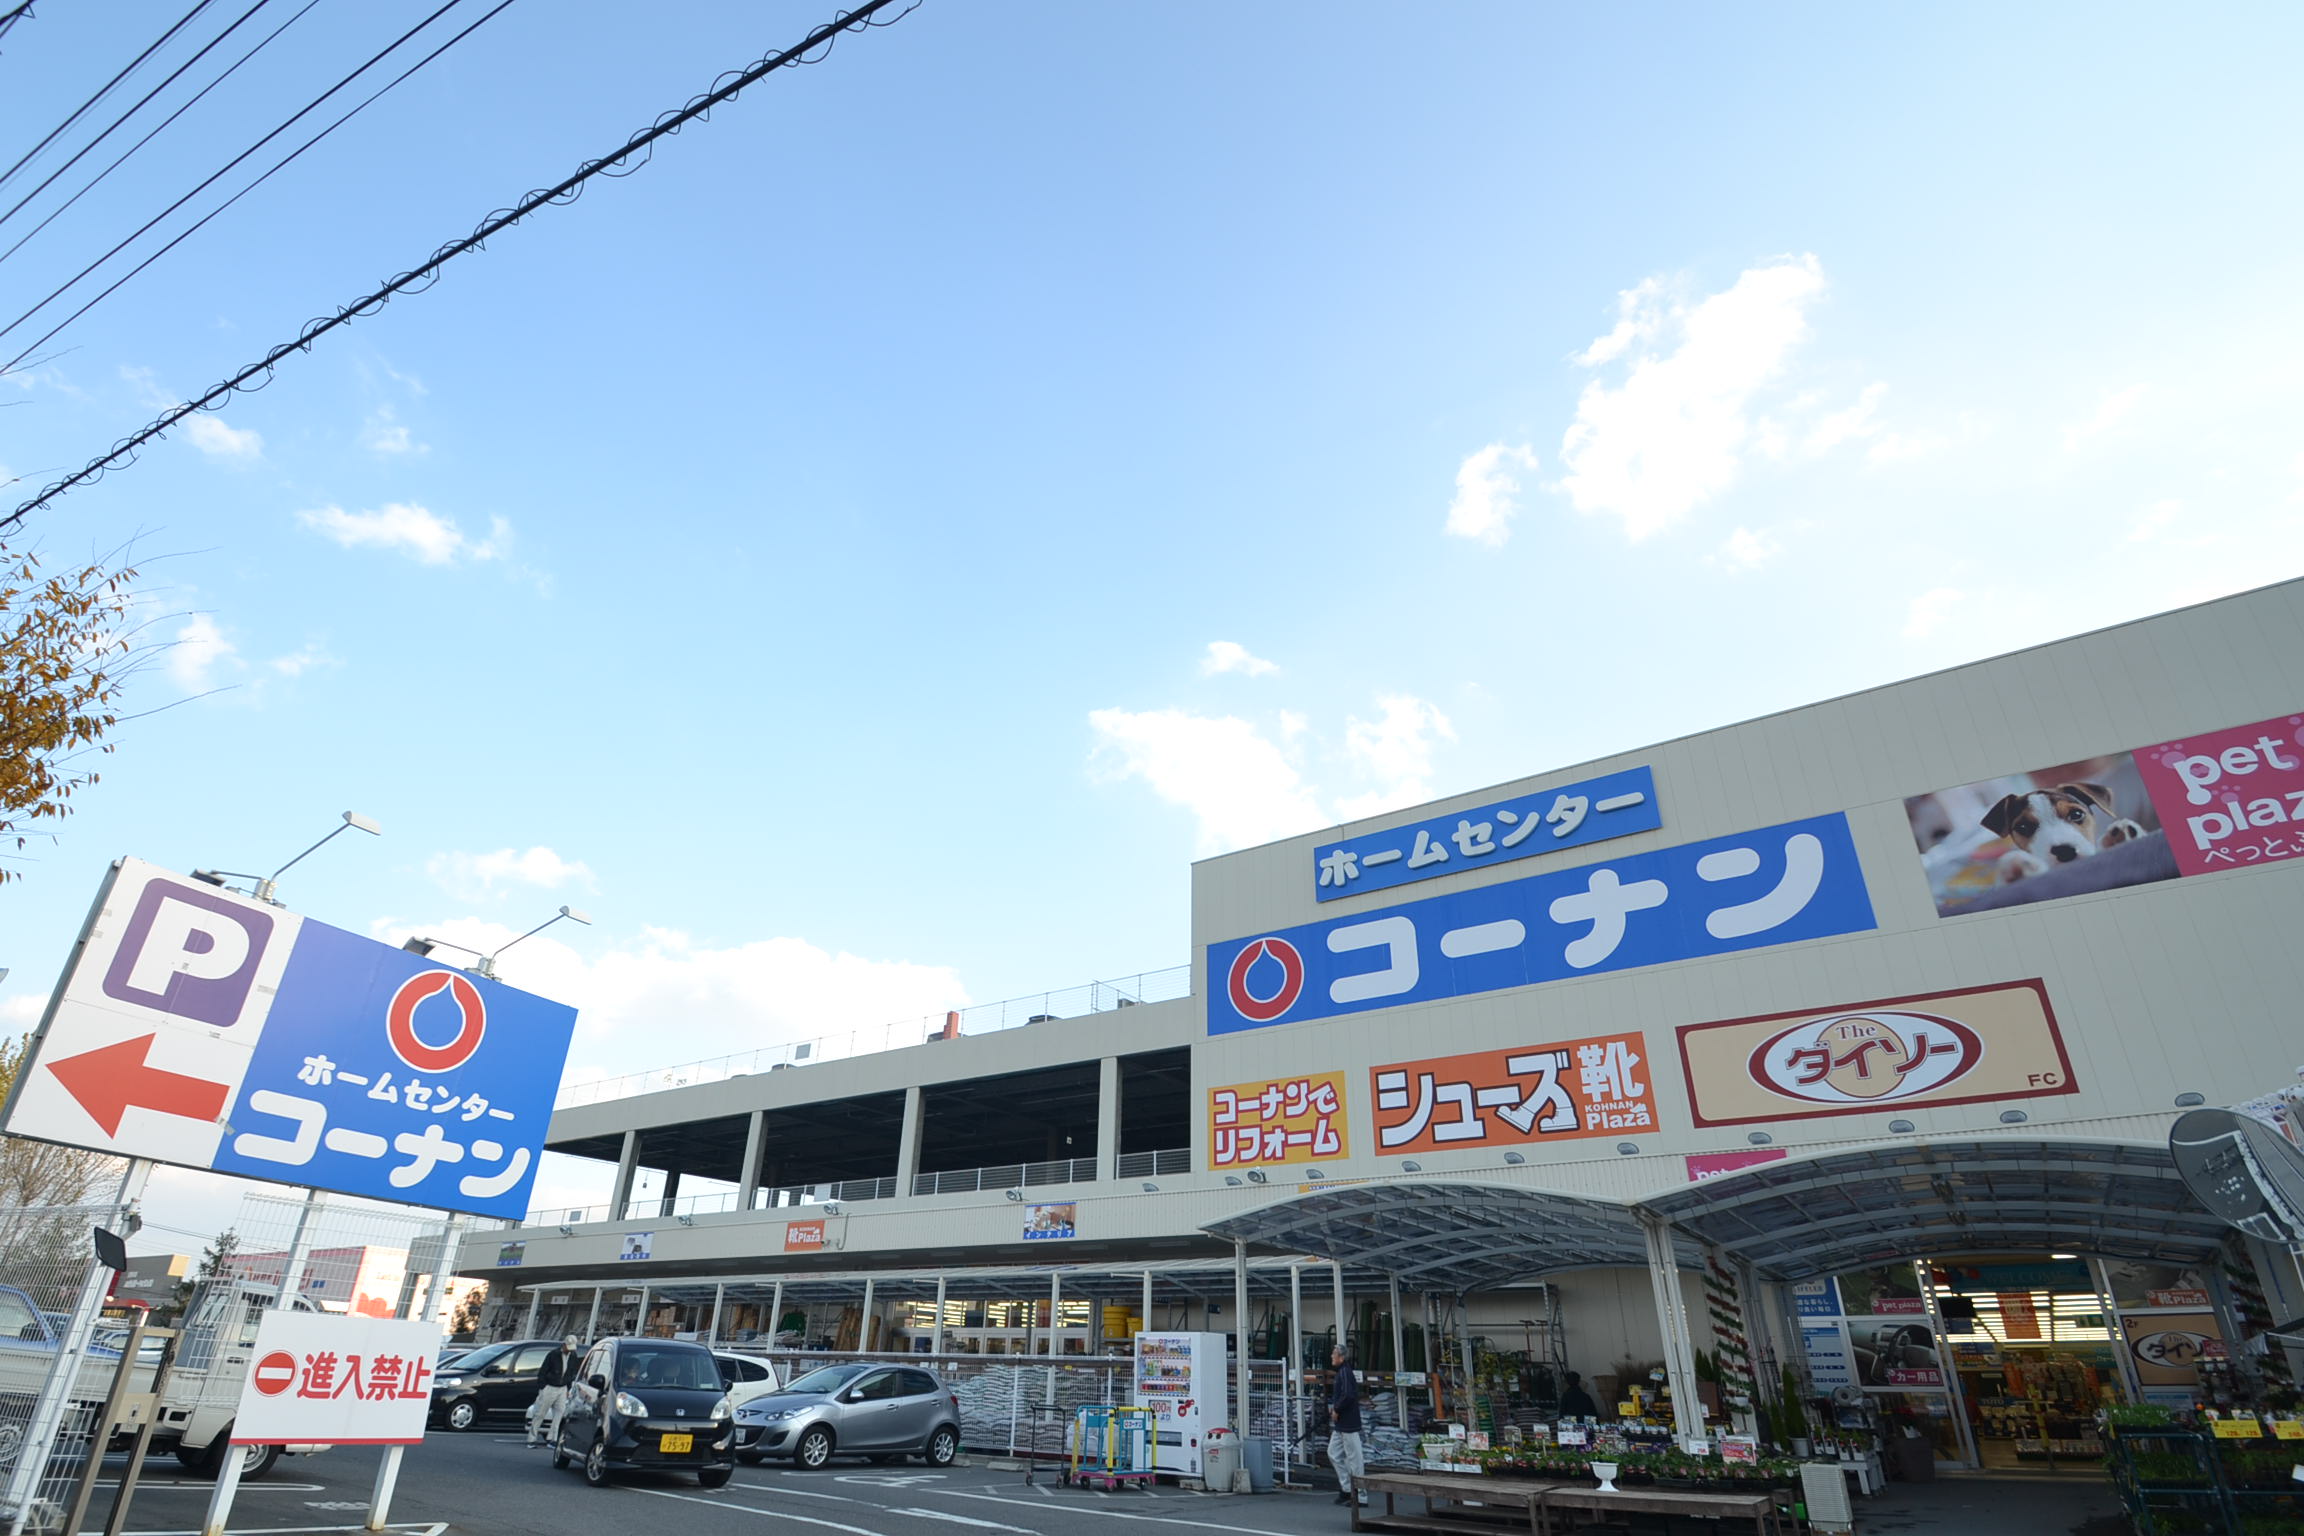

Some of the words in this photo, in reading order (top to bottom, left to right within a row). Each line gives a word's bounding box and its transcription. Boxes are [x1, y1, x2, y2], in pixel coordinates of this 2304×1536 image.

[2173, 736, 2295, 806] pet
[1318, 791, 1646, 888] ホームセンター
[1326, 833, 1824, 1004] コーナン
[126, 896, 250, 996] P
[1835, 1024, 1876, 1041] The
[1577, 1041, 1645, 1103] 靴
[1785, 1032, 1959, 1087] ダイソー
[2027, 1072, 2058, 1088] FC
[297, 1054, 515, 1122] ホームセンター
[1213, 1079, 1340, 1127] コーナンで
[1376, 1048, 1580, 1148] シューズ
[1585, 1101, 1634, 1113] KOHNAN
[233, 1090, 531, 1198] コーナン
[1214, 1117, 1342, 1167] リフォーム
[1586, 1111, 1651, 1130] Plaza
[799, 1232, 820, 1243] Plaza
[1882, 1302, 1897, 1311] pet
[1898, 1302, 1921, 1310] plaza
[2173, 1294, 2207, 1304] Plaza
[296, 1351, 431, 1401] 進入禁止
[1896, 1370, 1940, 1383] カー用品
